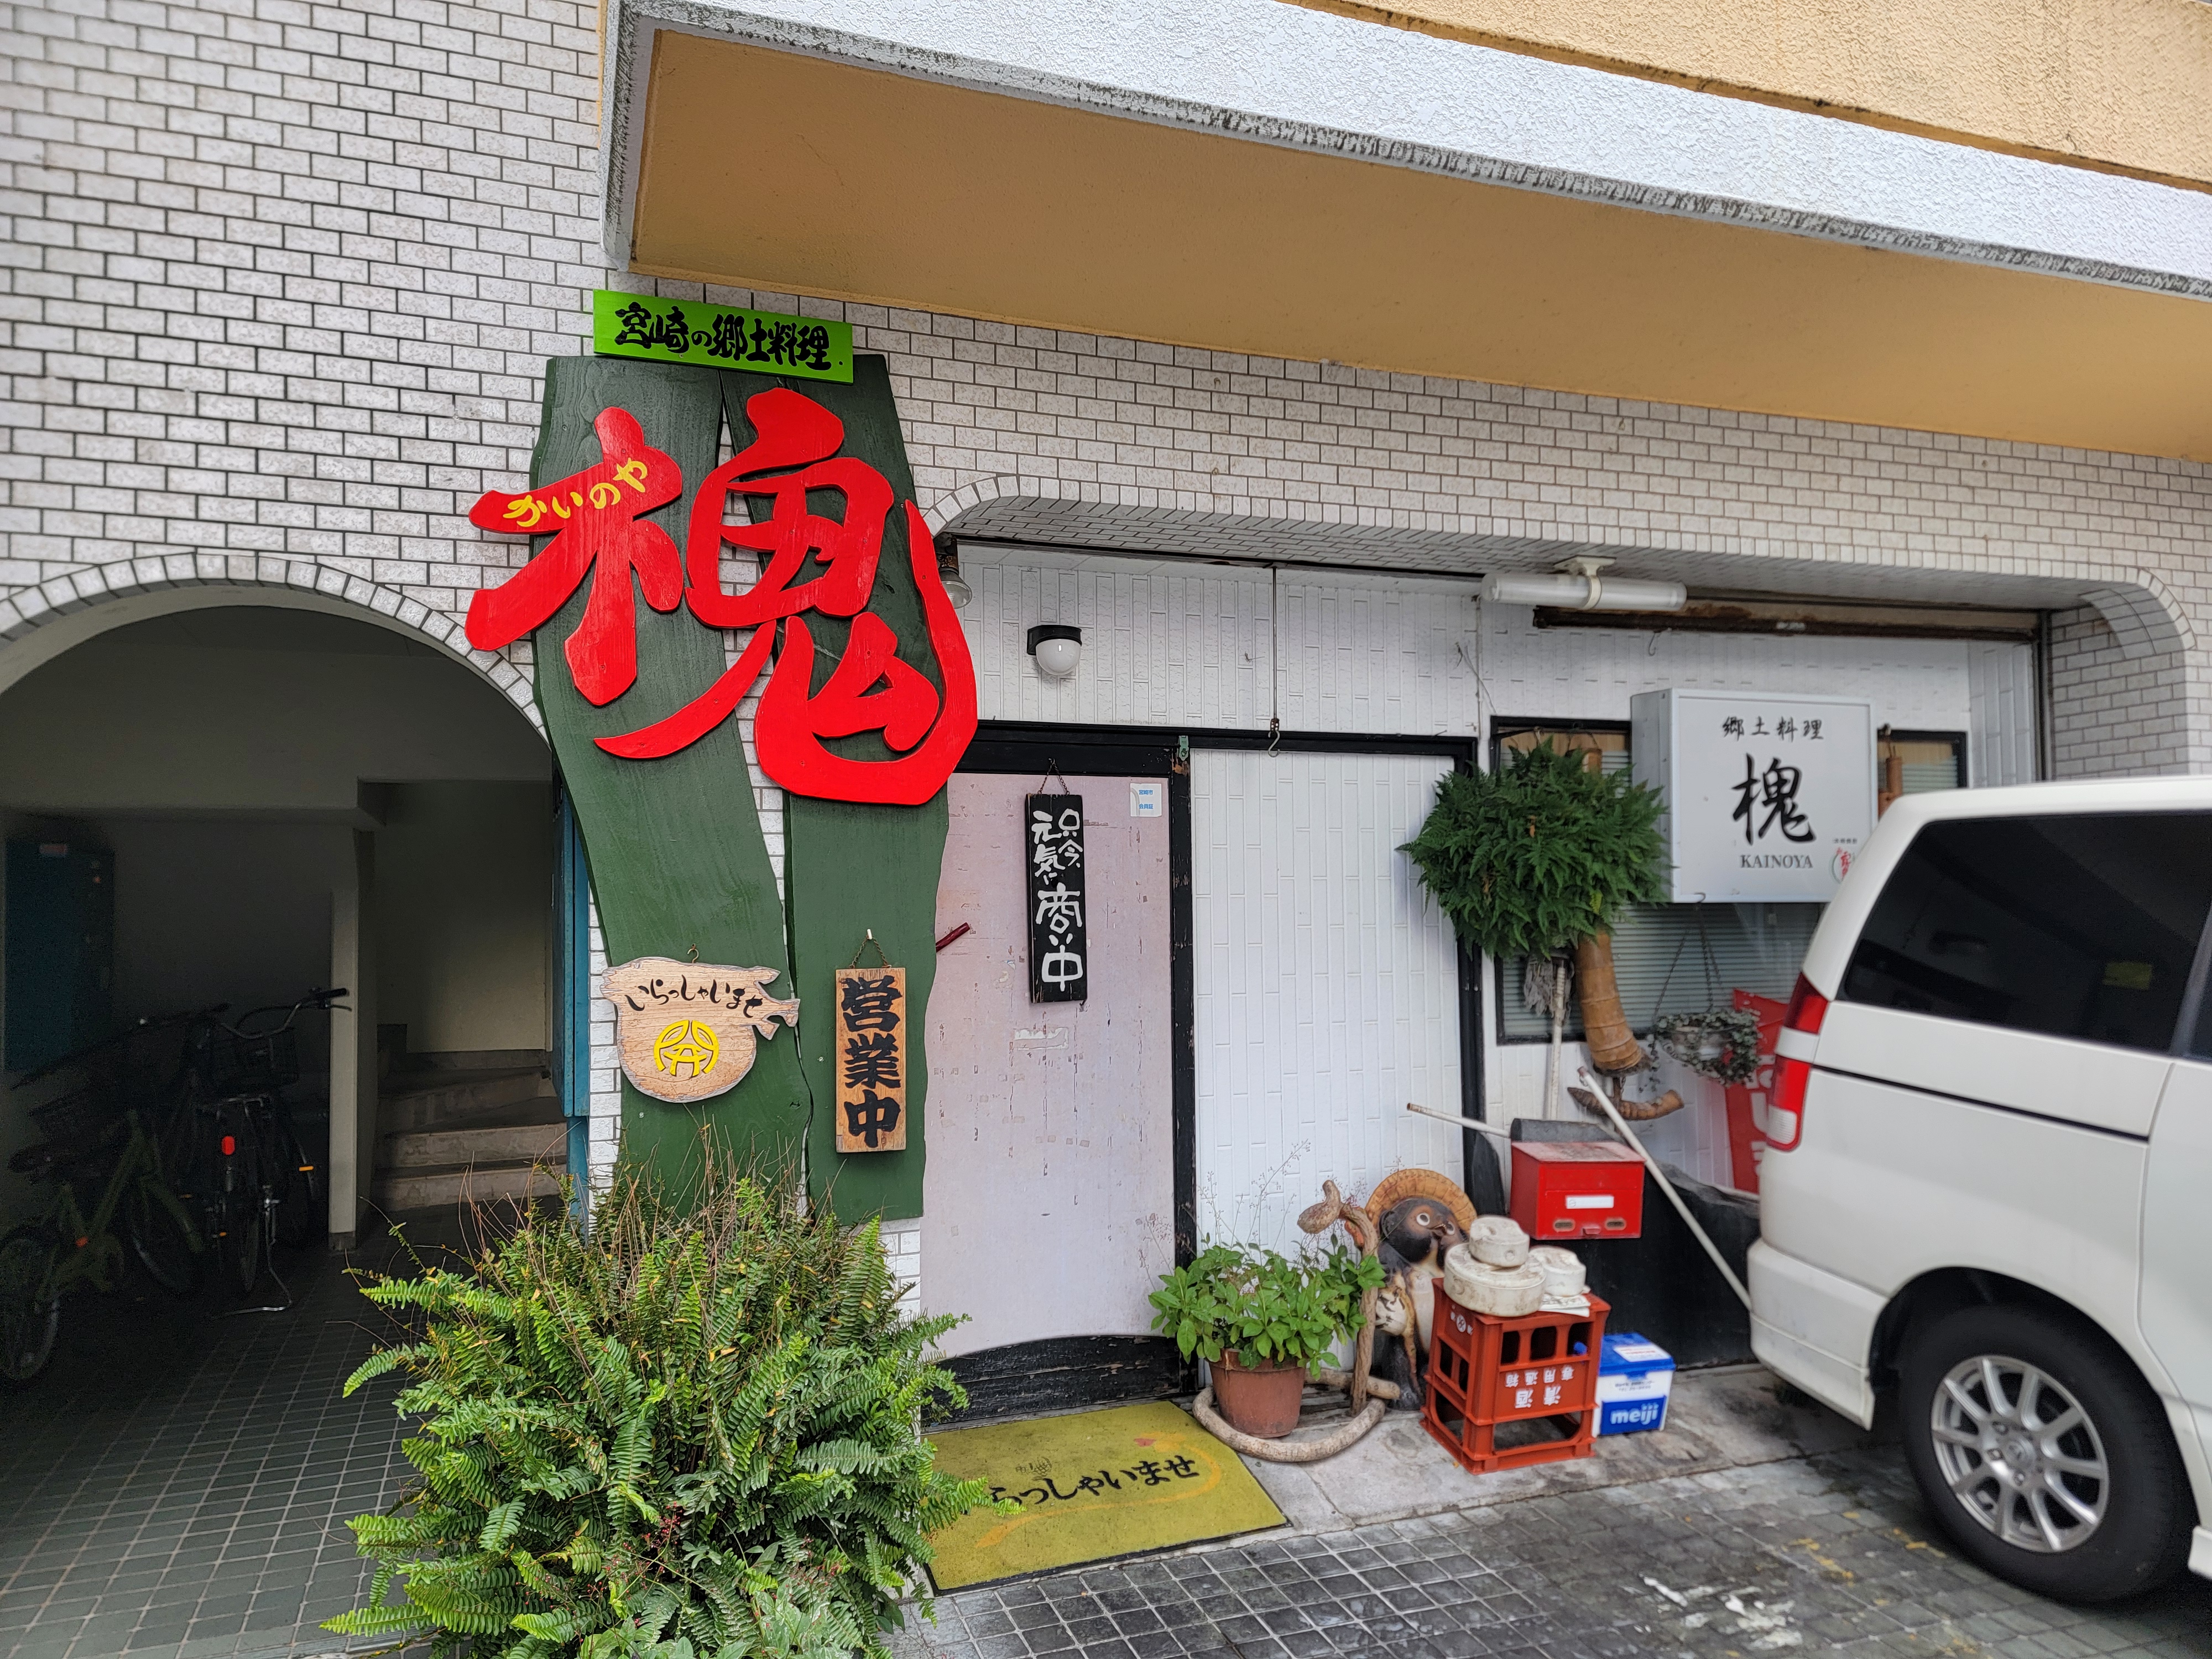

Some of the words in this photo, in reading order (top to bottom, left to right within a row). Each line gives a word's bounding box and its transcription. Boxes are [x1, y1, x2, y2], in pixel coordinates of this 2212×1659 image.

[614, 301, 832, 371] 宮崎の郷土料理
[503, 457, 648, 527] かいのや
[1722, 716, 1824, 742] 郷土料理
[1731, 752, 1817, 846] 槐
[1740, 854, 1813, 869] KAINOYA
[624, 974, 763, 1018] いらっしゃいませ
[841, 975, 902, 1148] 営業中
[1515, 1385, 1562, 1409] 清酒
[1610, 1402, 1660, 1425] meiji
[989, 1455, 1201, 1506] らっしゃいませ
